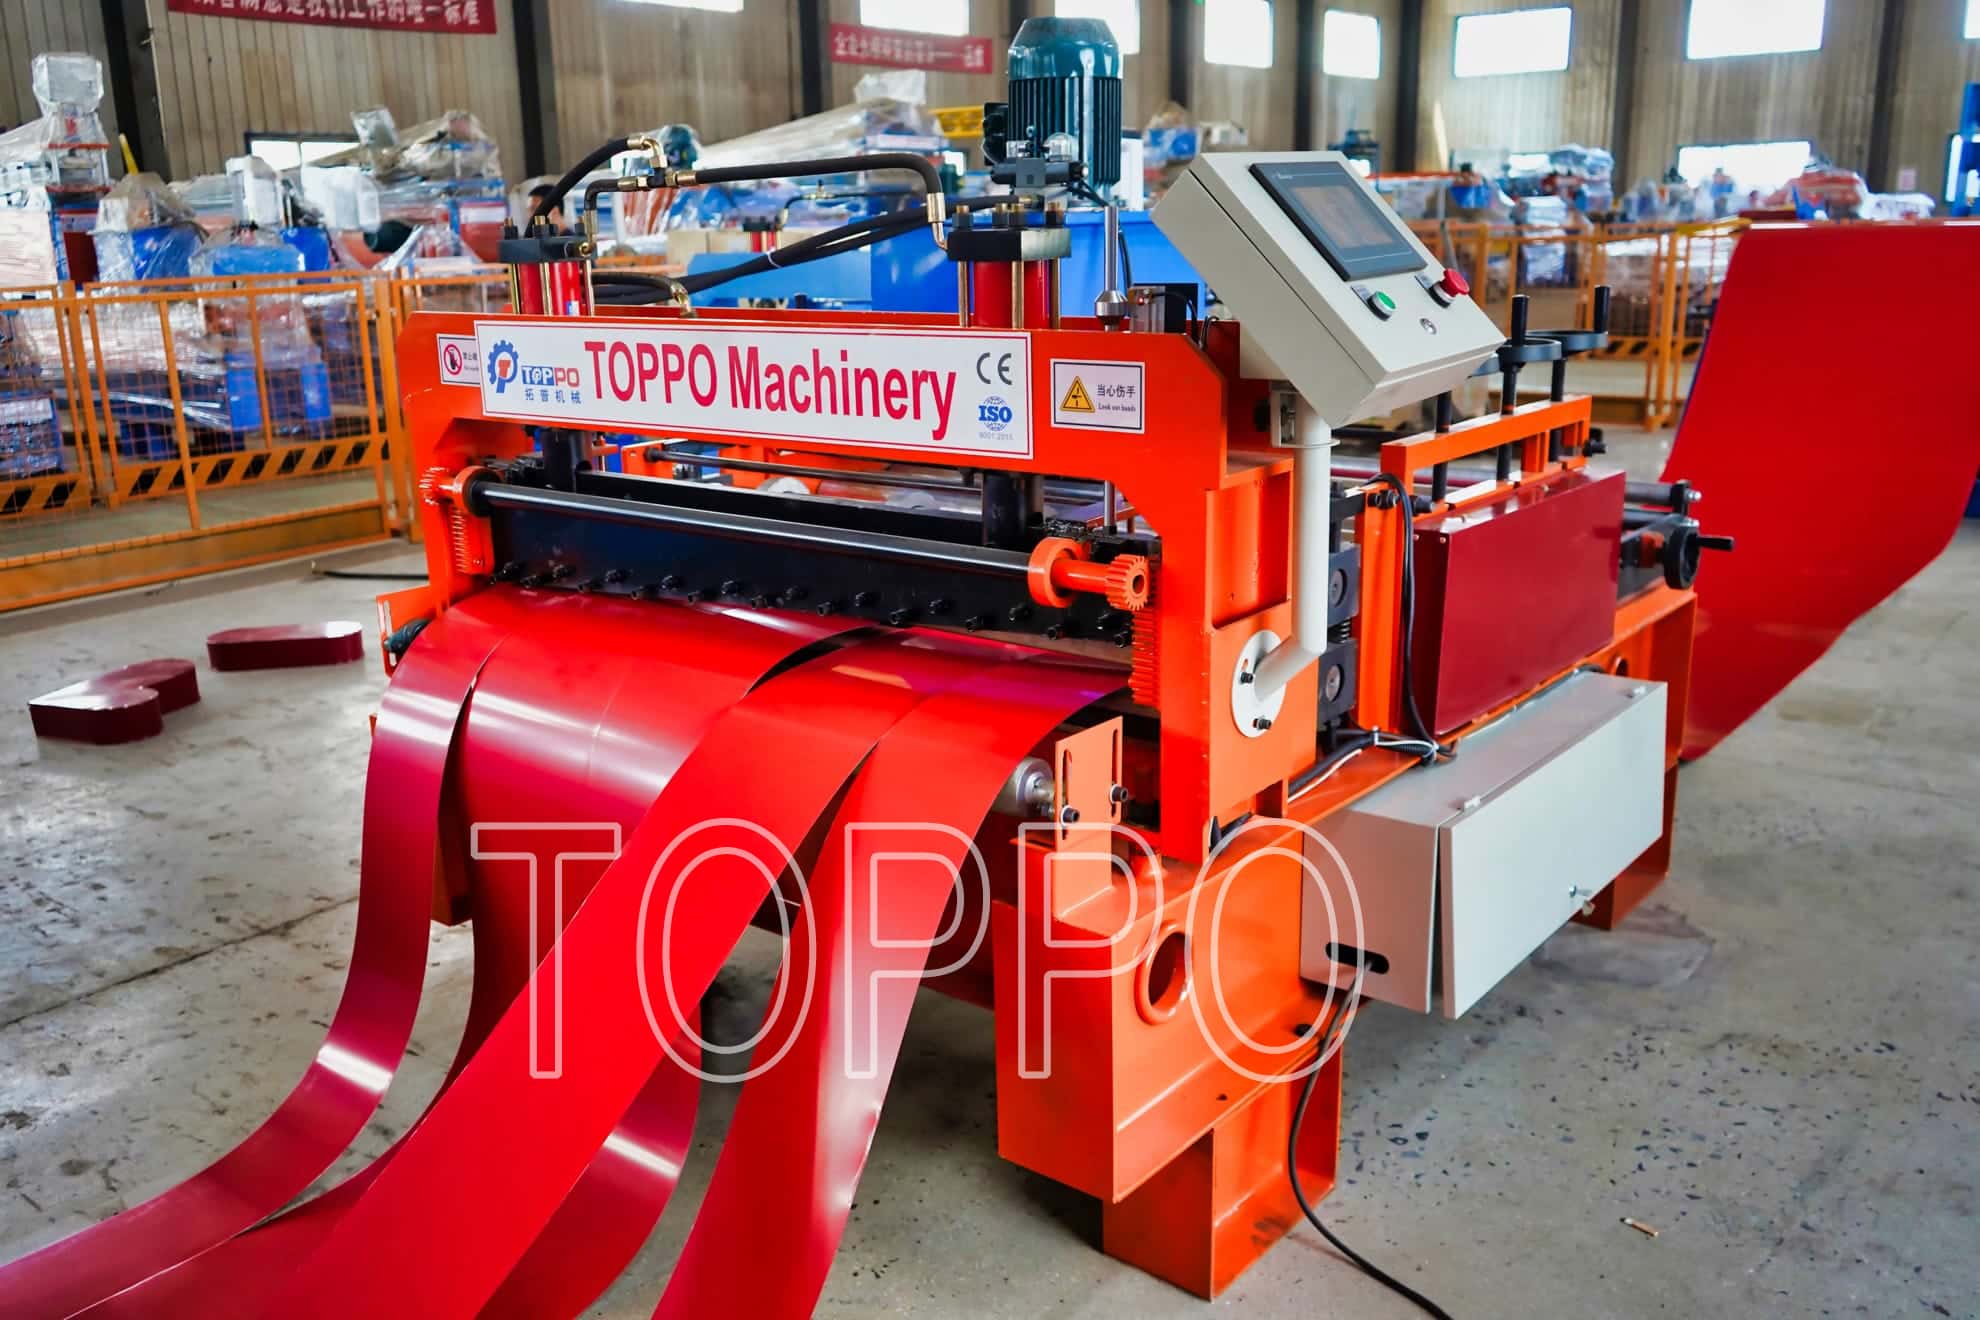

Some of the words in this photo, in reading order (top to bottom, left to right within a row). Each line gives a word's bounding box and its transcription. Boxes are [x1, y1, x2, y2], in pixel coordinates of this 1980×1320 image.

[521, 366, 580, 388] TOPPO
[976, 352, 1012, 386] CE
[584, 340, 717, 407] TOPPO
[728, 345, 956, 441] Machinery
[1096, 384, 1136, 399] 当心伤手
[978, 404, 1013, 424] ISO
